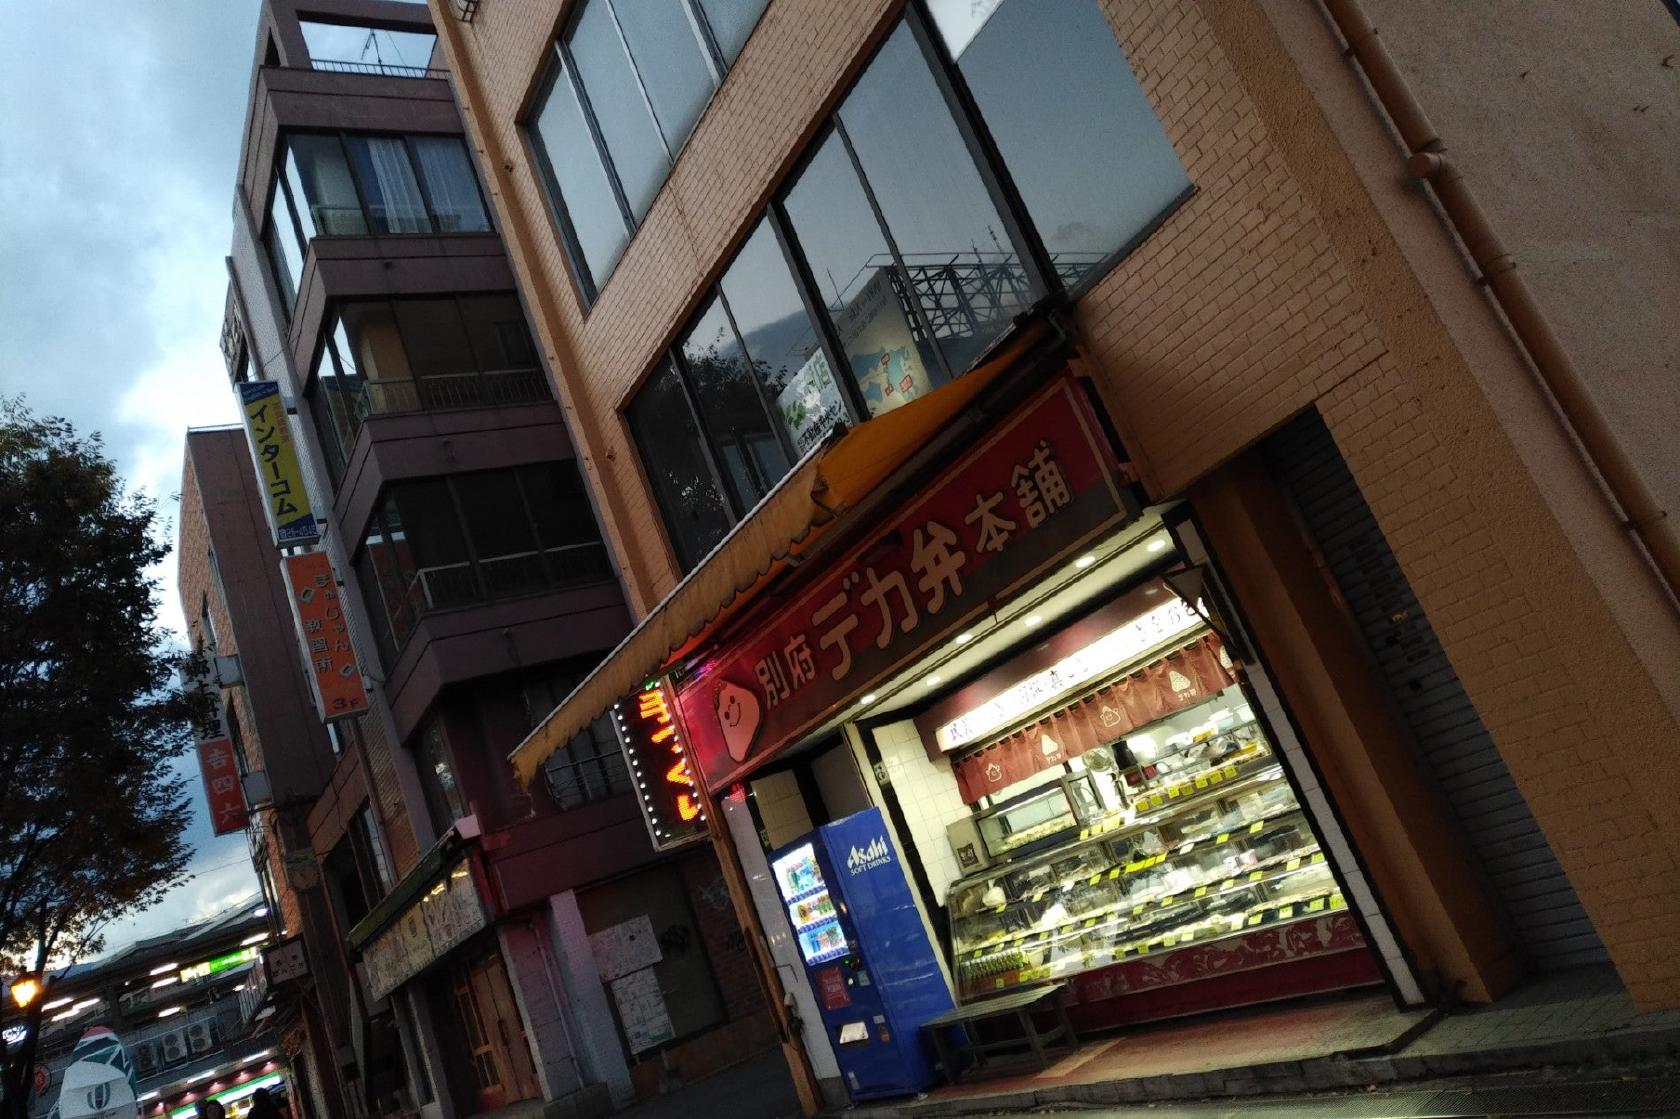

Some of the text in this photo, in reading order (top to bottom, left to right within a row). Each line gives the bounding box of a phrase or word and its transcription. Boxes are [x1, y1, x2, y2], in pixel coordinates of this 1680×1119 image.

[251, 404, 298, 516] インターコム
[333, 698, 360, 710] 3F
[206, 748, 241, 824] 吉四六
[847, 834, 888, 869] Asahi
[850, 856, 891, 876] SOFT DRINKS
